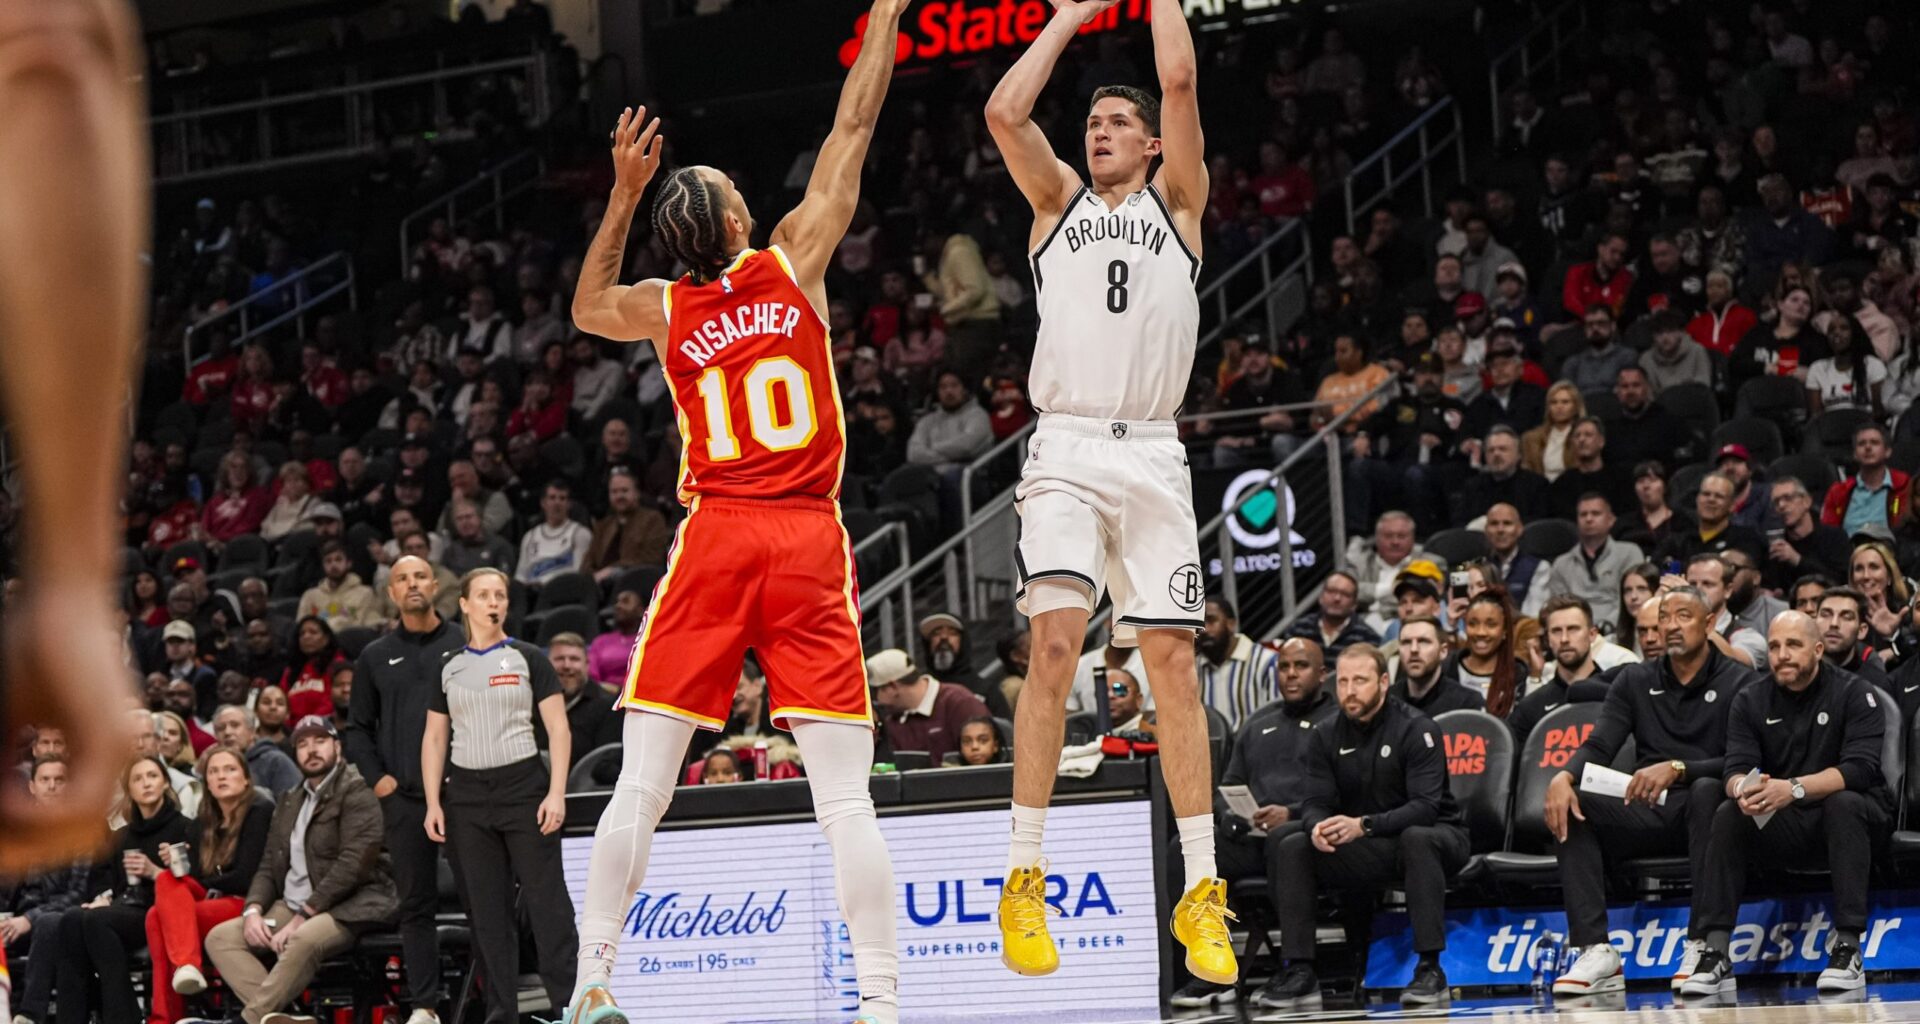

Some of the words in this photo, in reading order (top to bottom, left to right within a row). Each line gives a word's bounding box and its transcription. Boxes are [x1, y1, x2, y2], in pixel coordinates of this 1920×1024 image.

[916, 0, 1045, 58] State
[1065, 214, 1167, 255] BROOKLYN
[1107, 260, 1128, 313] 8
[680, 303, 800, 367] RISACHER
[696, 355, 819, 462] 10
[1209, 549, 1316, 575] sarecre
[1185, 571, 1198, 604] B
[1443, 733, 1487, 757] APA
[1545, 723, 1595, 749] PAP
[1447, 757, 1486, 775] HNS
[621, 889, 788, 939] Michelob
[907, 941, 999, 957] SUPERIOR
[1078, 935, 1125, 949] BEER
[639, 956, 661, 973] 26
[665, 960, 694, 969] CARBS
[706, 953, 728, 970] 95
